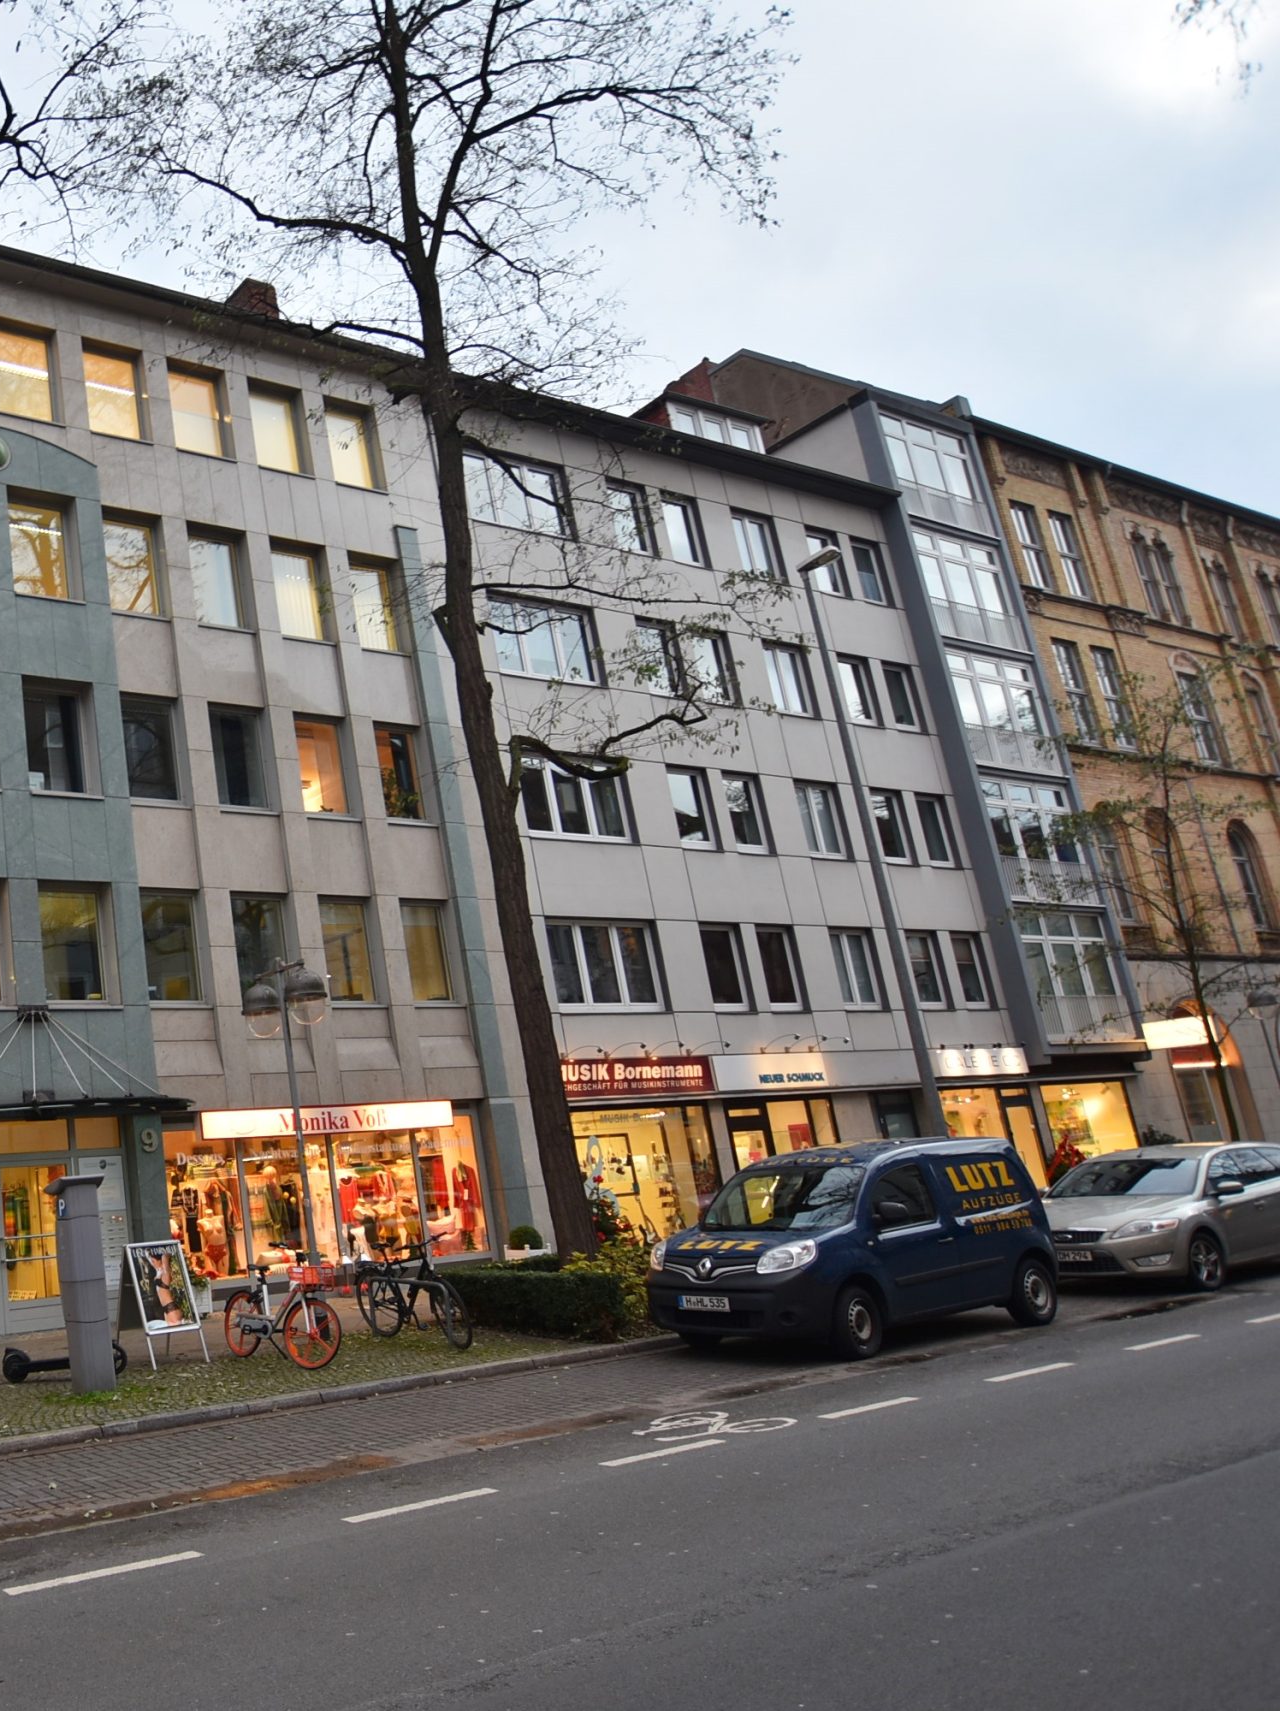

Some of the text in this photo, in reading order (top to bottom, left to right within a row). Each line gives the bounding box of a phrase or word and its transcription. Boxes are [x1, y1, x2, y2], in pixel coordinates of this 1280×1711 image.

[945, 1055, 1000, 1069] GALEE
[614, 1063, 704, 1081] Bornemann
[759, 1072, 825, 1084] NEUER SCHMUCK
[614, 1080, 629, 1090] FÜR
[631, 1079, 704, 1089] MUSIKINSTRUMENTE
[279, 1110, 351, 1133] Monika
[140, 1128, 159, 1152] 9
[945, 1161, 1016, 1193] LUTZ
[962, 1191, 1022, 1210] AUFZÜGE
[677, 1240, 766, 1251] LUTZ
[709, 1298, 726, 1309] 535
